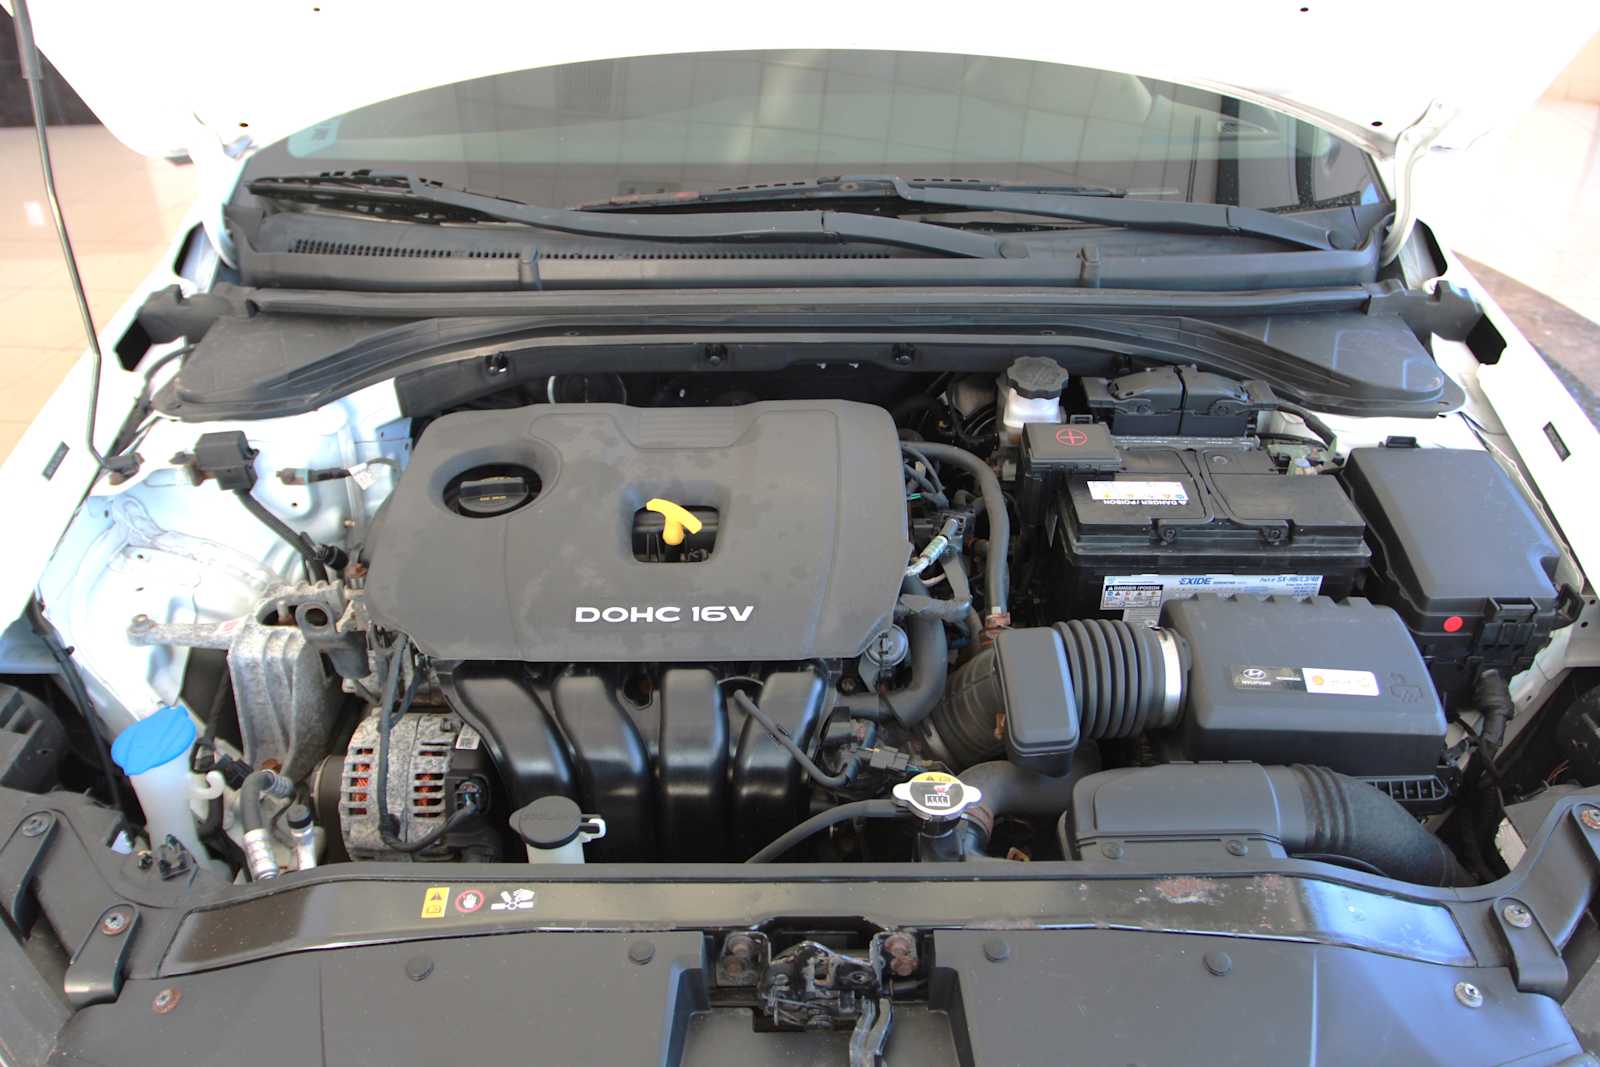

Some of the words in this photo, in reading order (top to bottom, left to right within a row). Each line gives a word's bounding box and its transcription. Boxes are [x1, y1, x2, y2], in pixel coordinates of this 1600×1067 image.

[1179, 577, 1213, 585] EXIDE
[575, 606, 681, 623] DOHC
[691, 605, 754, 622] 16V
